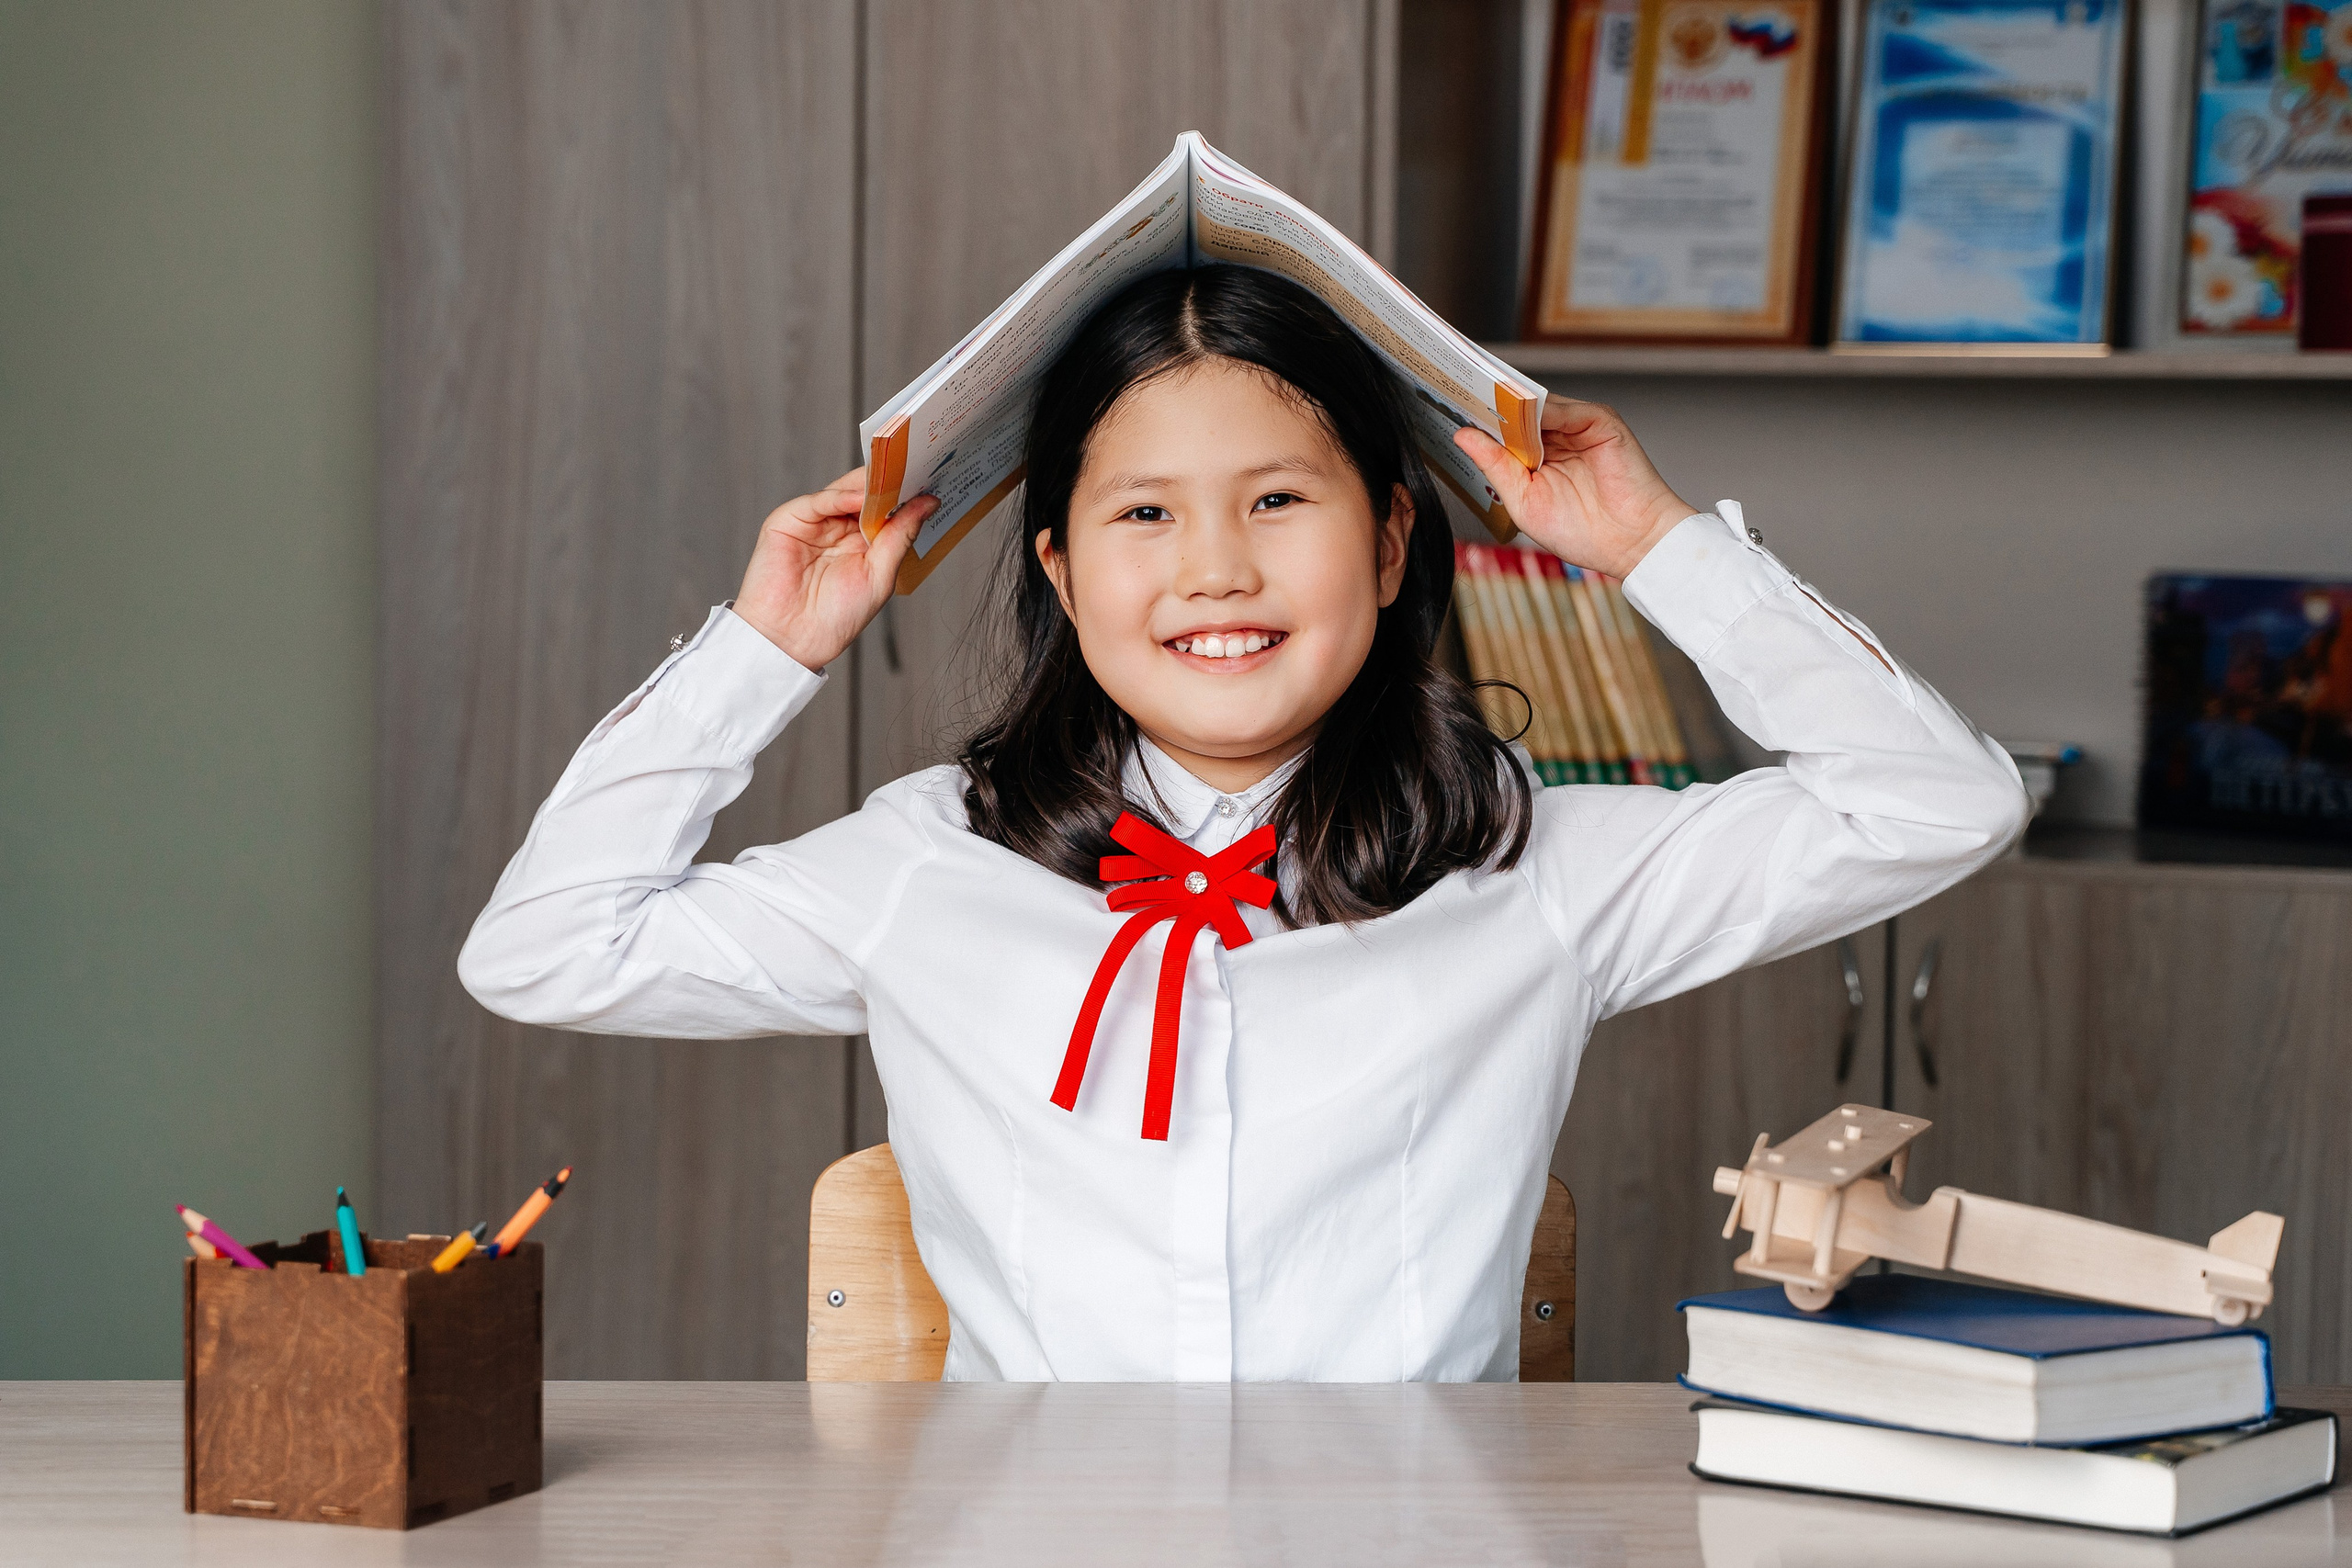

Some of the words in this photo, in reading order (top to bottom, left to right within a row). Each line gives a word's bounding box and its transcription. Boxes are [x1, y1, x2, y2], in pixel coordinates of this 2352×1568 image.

[1212, 186, 1262, 209] Обрати
[1208, 206, 1243, 224] Какое
[1209, 220, 1252, 239] Чтобы
[1234, 220, 1269, 235] сова?
[1211, 233, 1243, 246] надо
[1211, 239, 1269, 257] дарный
[948, 457, 981, 488] теперь
[930, 490, 969, 531] ударный
